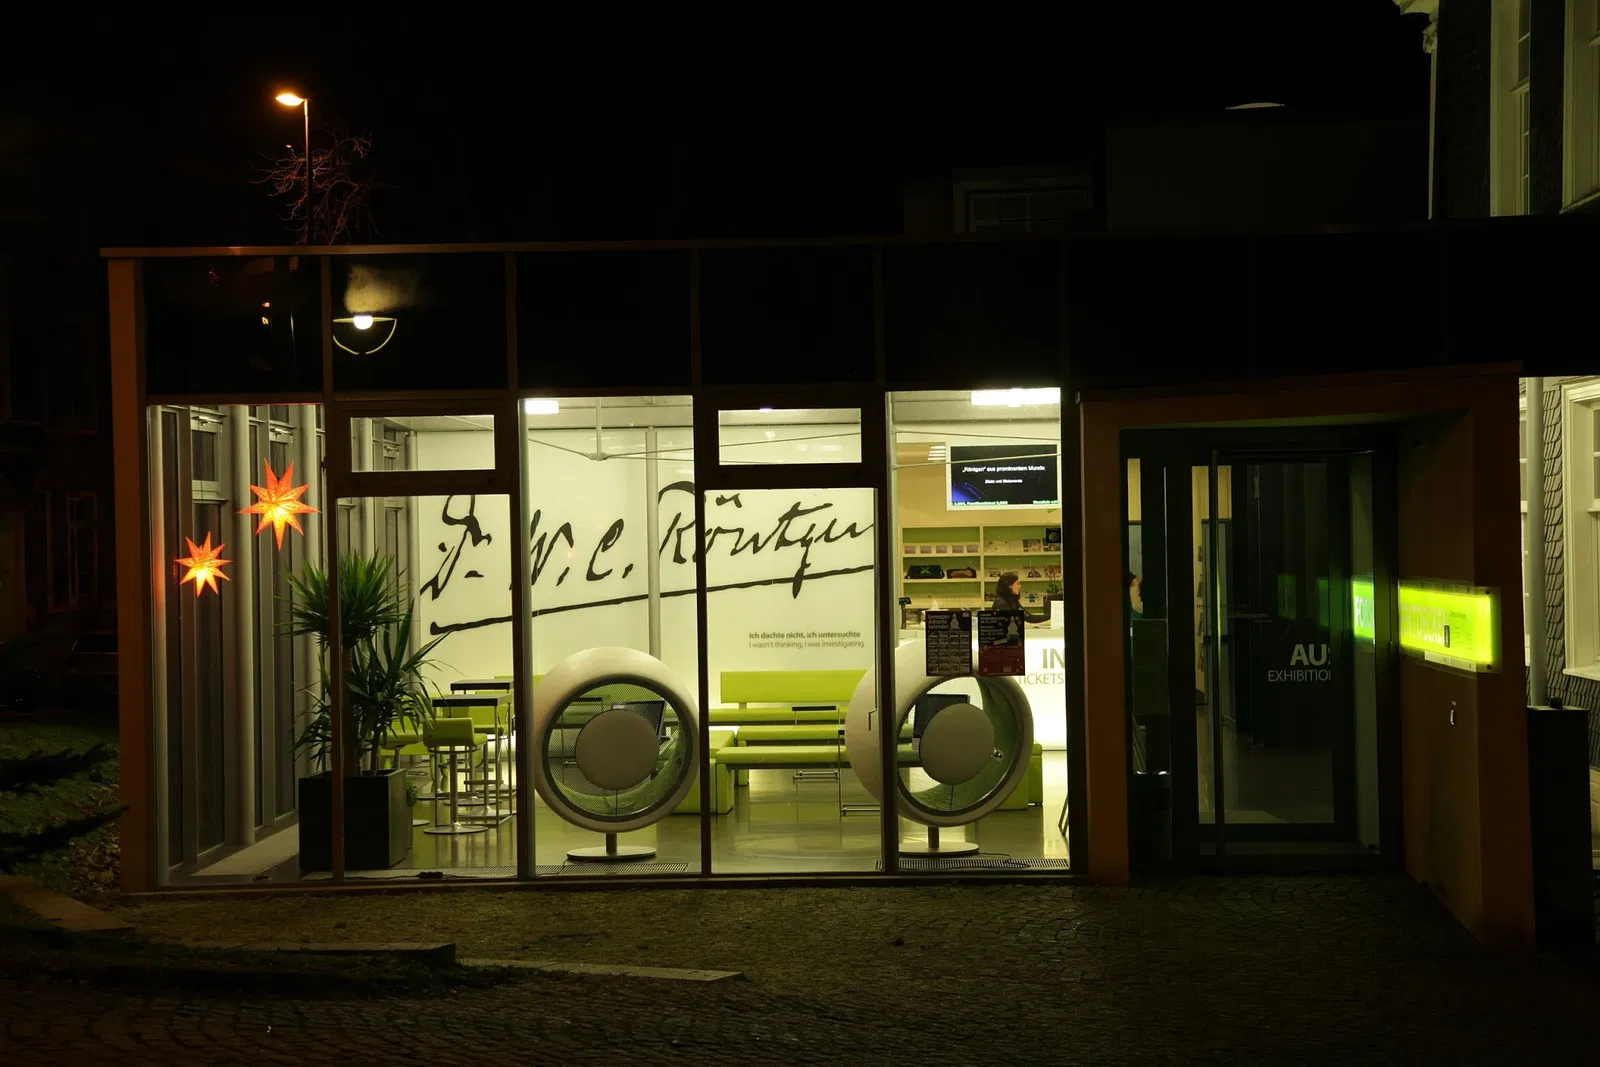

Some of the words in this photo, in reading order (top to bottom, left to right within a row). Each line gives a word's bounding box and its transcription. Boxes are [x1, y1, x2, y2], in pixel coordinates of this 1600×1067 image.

[760, 631, 785, 639] dachte
[786, 631, 806, 640] nicht,
[807, 631, 817, 639] ich
[818, 630, 861, 638] untersuchte
[775, 641, 804, 649] thinking,
[822, 640, 865, 649] investigating
[1290, 644, 1331, 666] AU
[1267, 669, 1331, 682] EXHIBITIO
